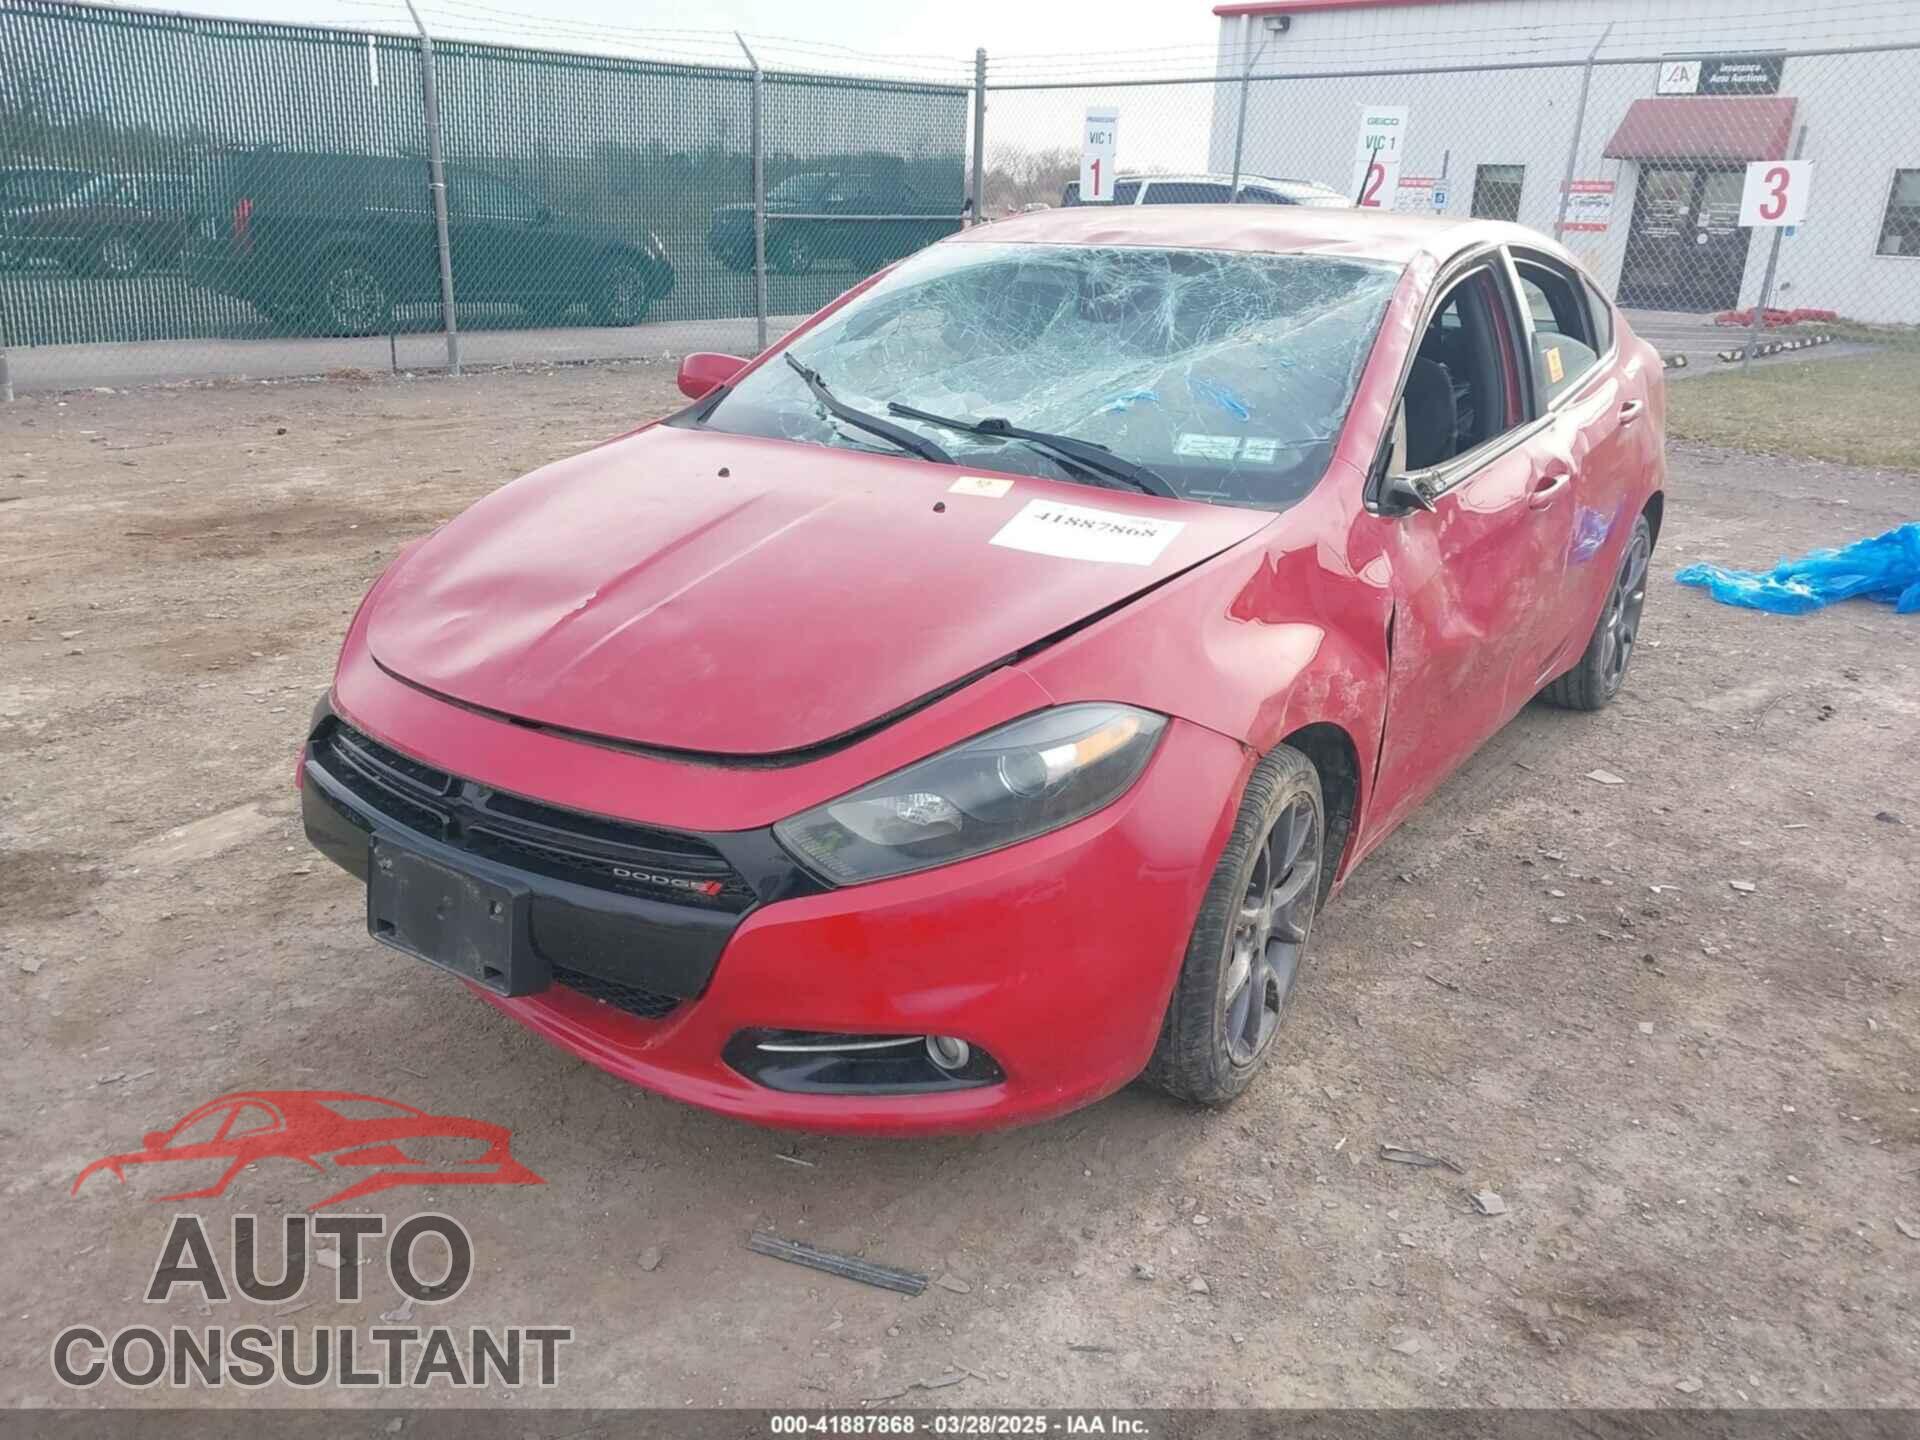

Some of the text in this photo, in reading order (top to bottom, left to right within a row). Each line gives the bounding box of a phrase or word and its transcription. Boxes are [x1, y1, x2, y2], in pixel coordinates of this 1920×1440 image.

[1367, 117, 1399, 126] GEICO
[1089, 131, 1113, 145] VIC 1
[1366, 135, 1396, 150] VIC 1
[1090, 158, 1101, 196] 1
[1361, 163, 1385, 207] 2
[1760, 167, 1790, 220] 3
[613, 867, 698, 888] DODGE
